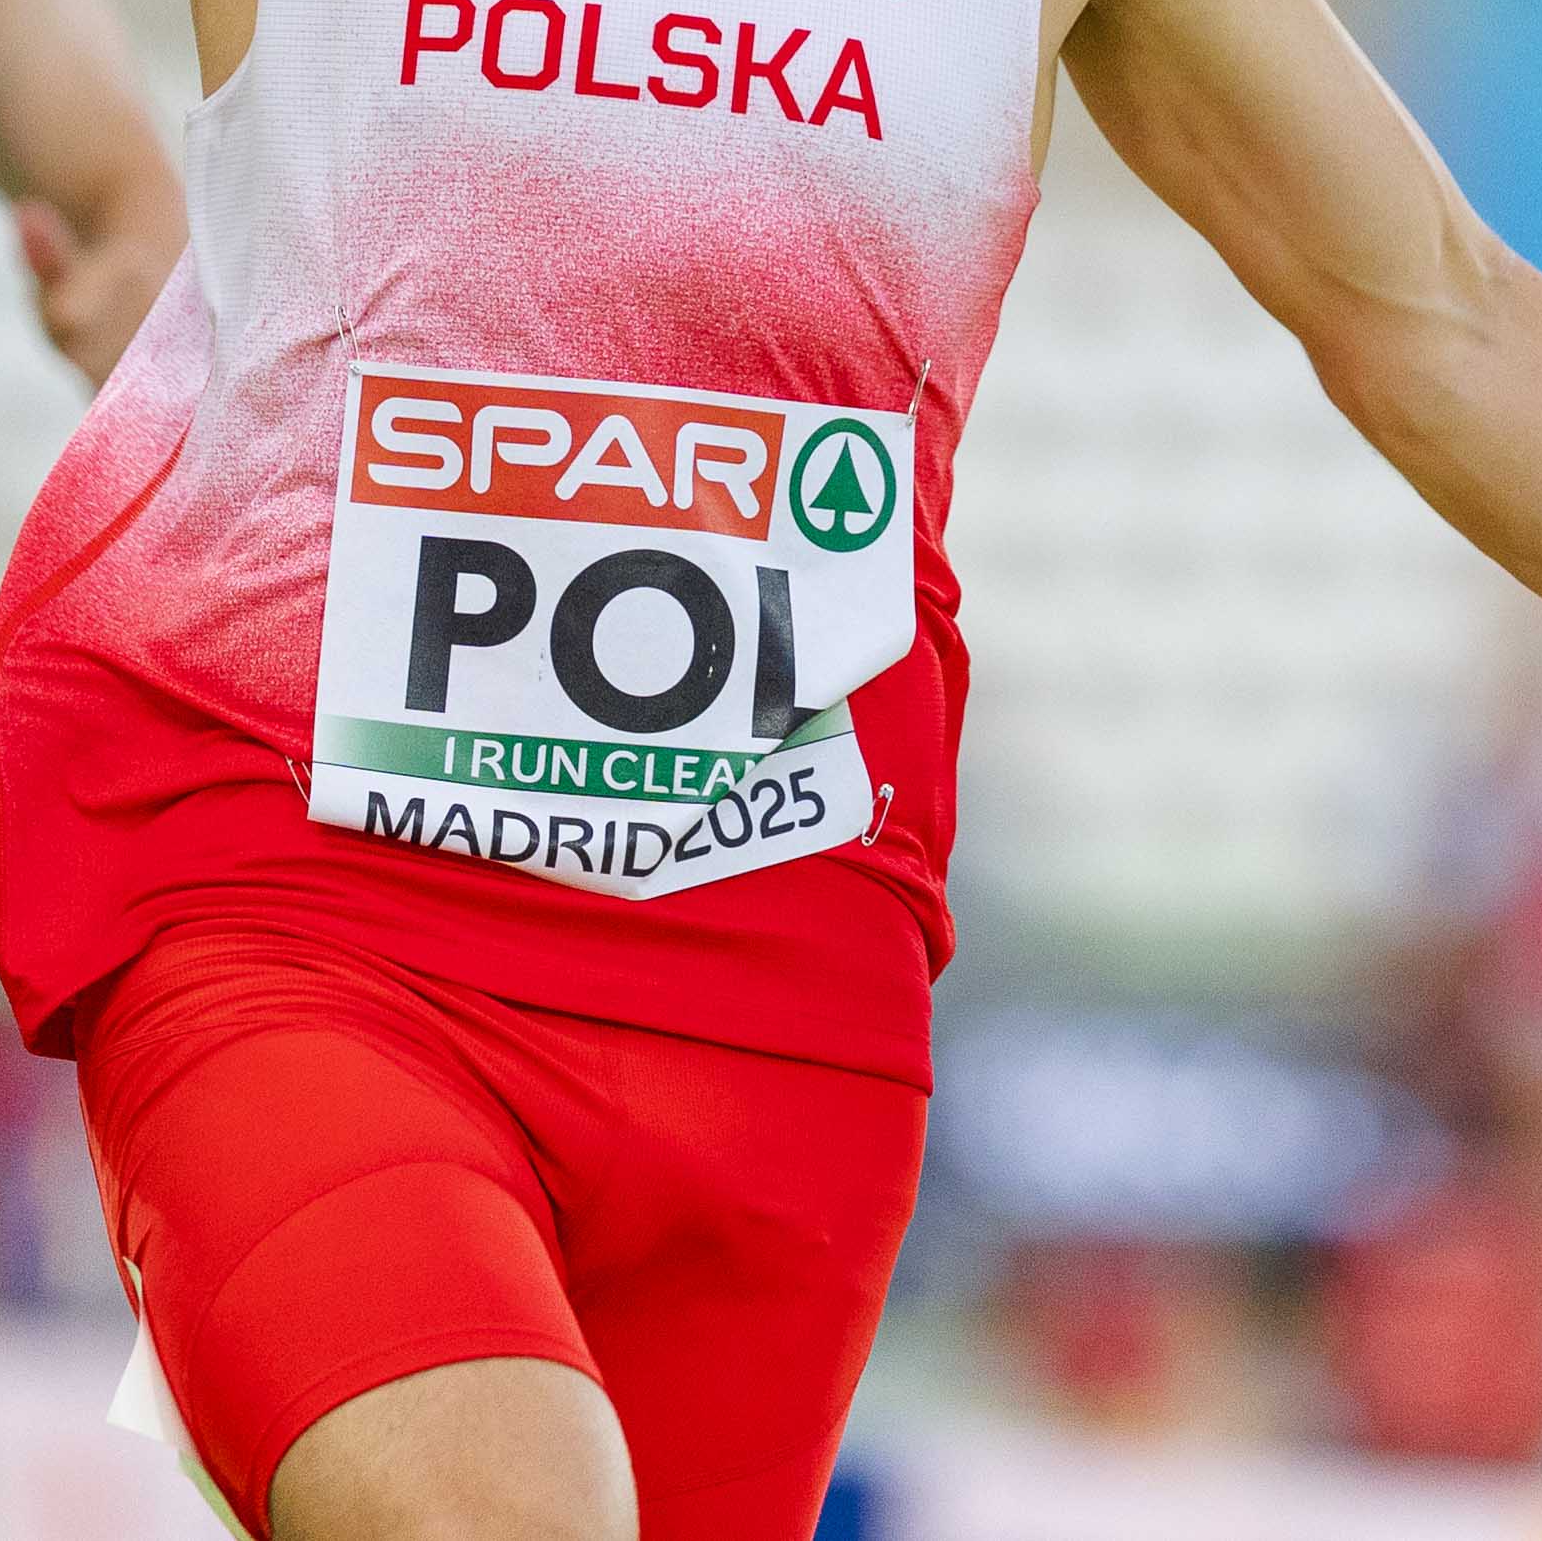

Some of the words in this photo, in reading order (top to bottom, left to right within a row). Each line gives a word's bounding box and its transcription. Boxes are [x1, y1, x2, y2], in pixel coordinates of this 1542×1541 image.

[367, 396, 768, 520] SPAR
[443, 737, 455, 776] I
[470, 739, 586, 789] RUN
[363, 791, 674, 880] MADRID
